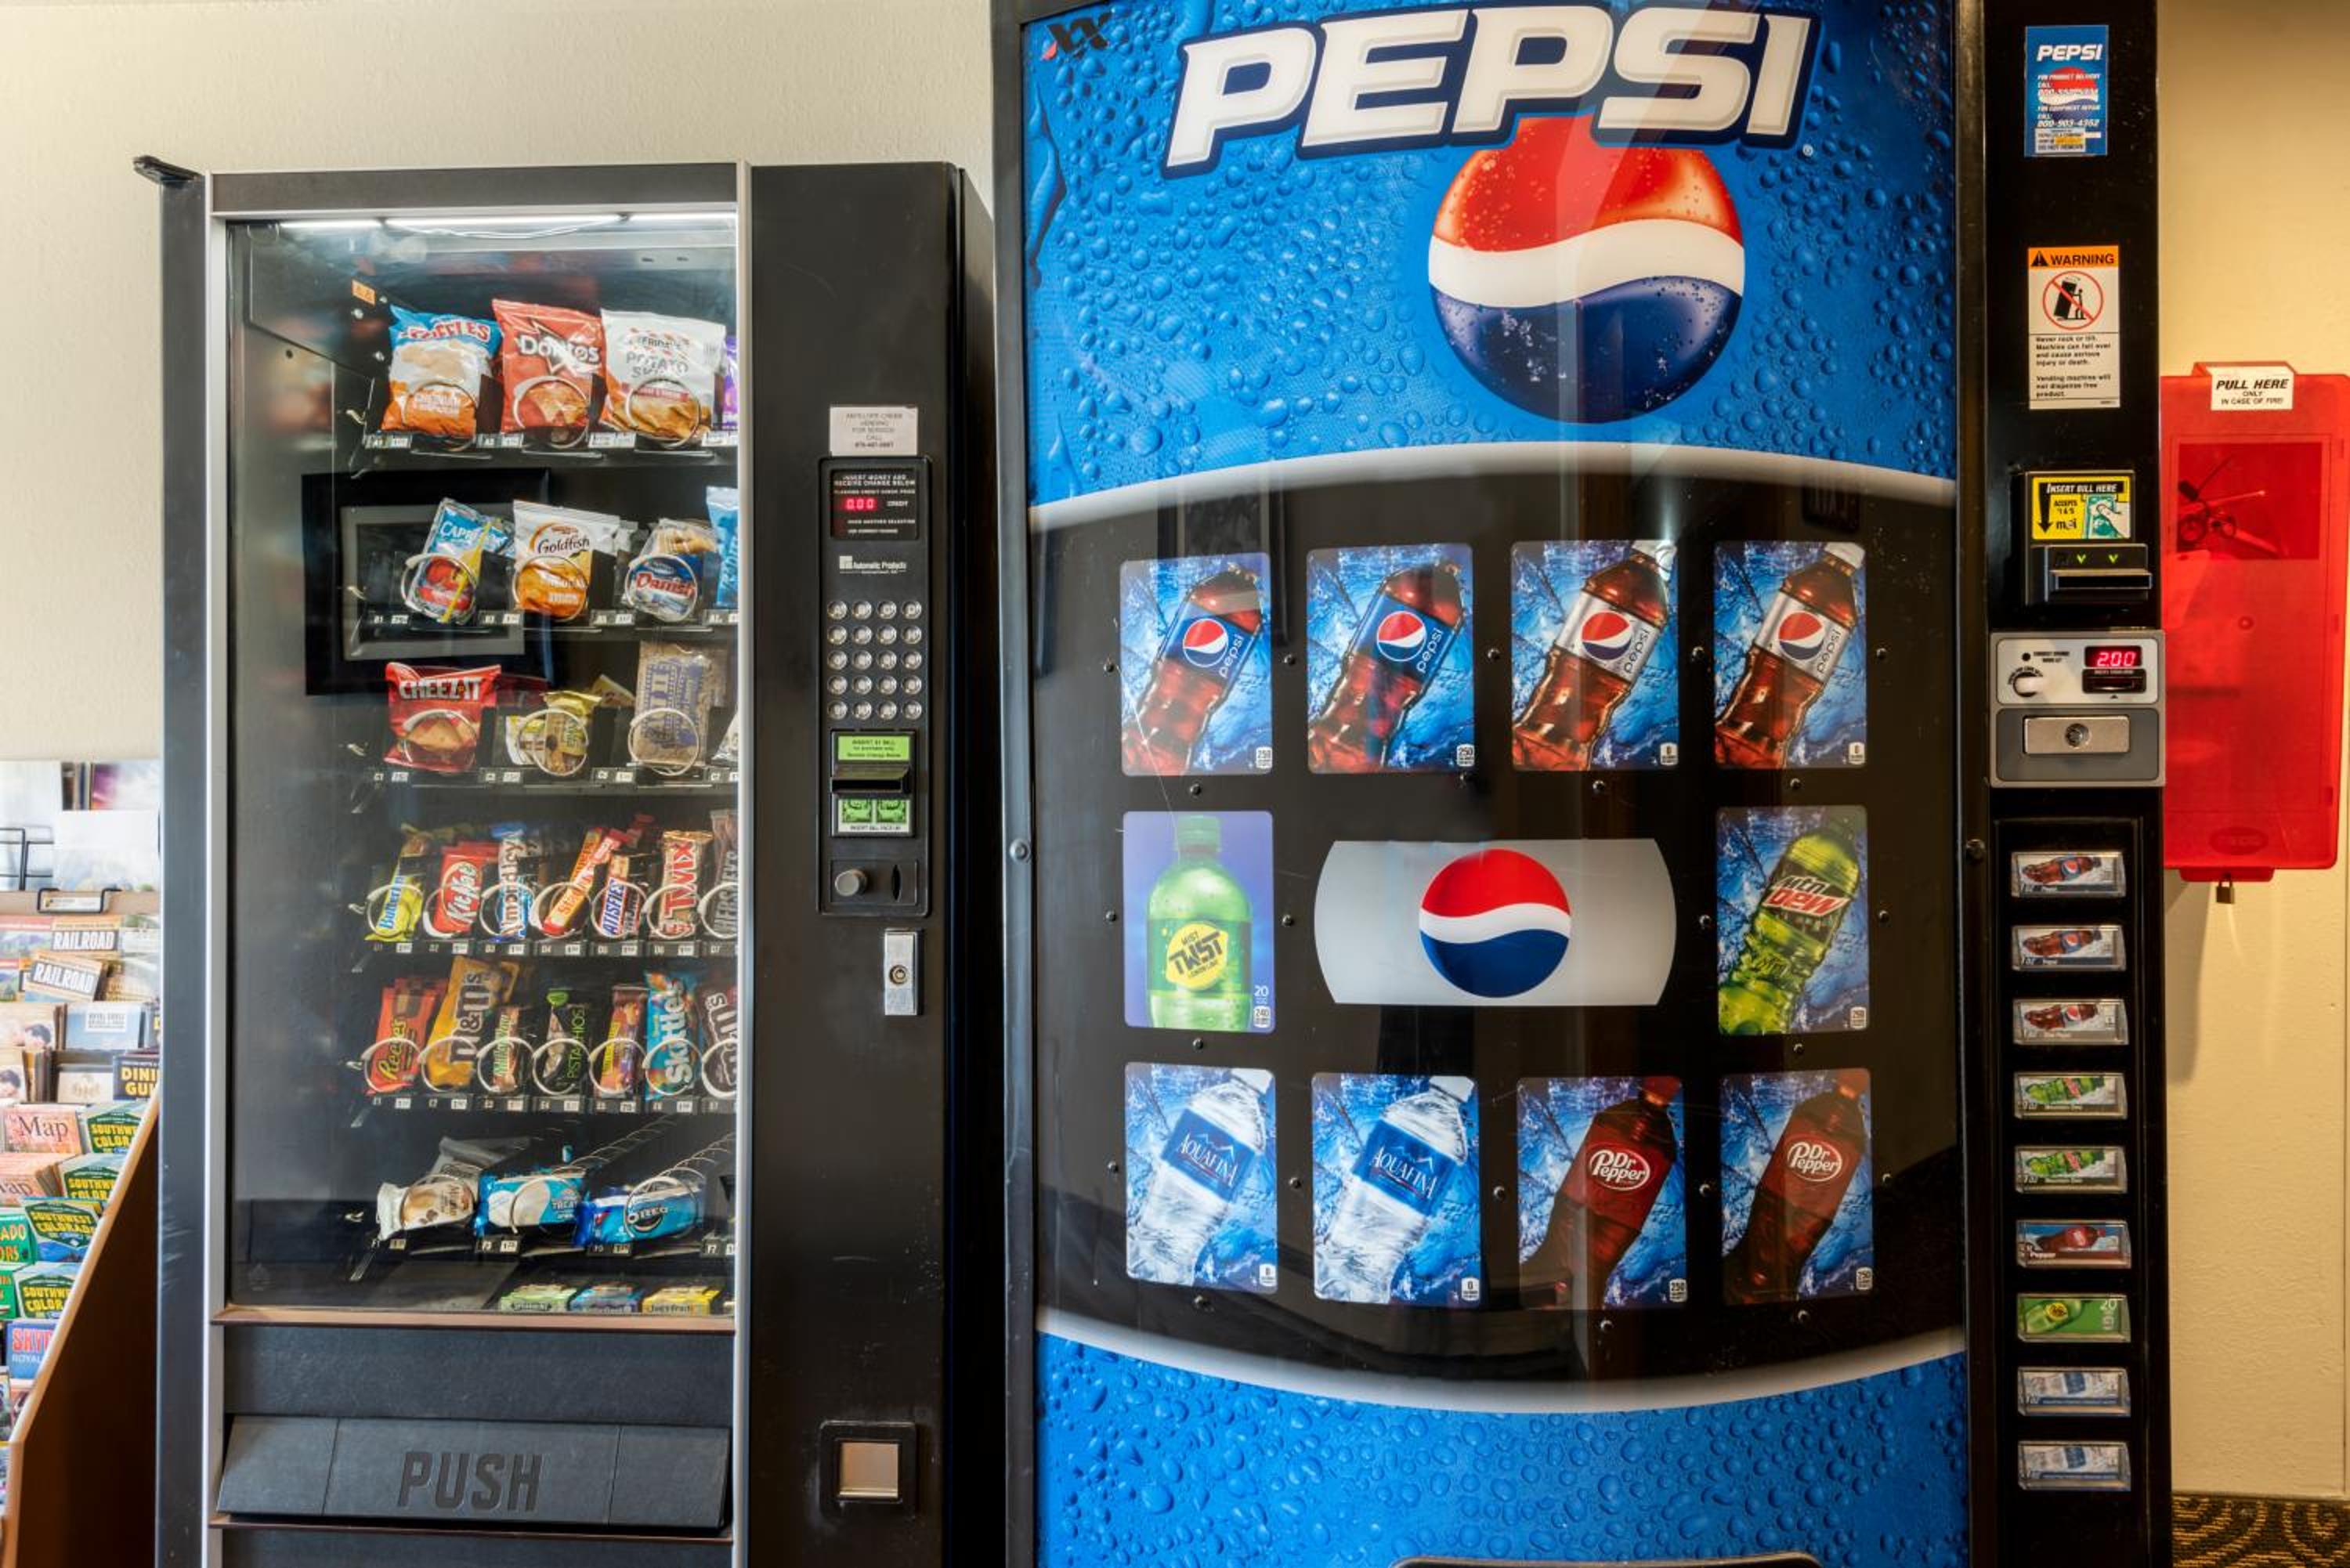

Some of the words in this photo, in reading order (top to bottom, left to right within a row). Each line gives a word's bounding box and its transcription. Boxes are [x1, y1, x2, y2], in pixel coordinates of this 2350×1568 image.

[2037, 44, 2102, 62] PEPSI
[1166, 5, 1812, 167] PEPSI
[2050, 254, 2114, 266] WARNING
[2216, 379, 2248, 390] PULL
[2254, 379, 2289, 390] HERE
[2047, 484, 2075, 493] INSERT
[2077, 484, 2094, 493] BILL
[2095, 484, 2117, 493] HERE
[537, 536, 591, 555] Goldfish
[635, 573, 696, 598] Danish
[1219, 633, 1244, 679] pepsi
[1416, 627, 1444, 674] pepsi
[1624, 627, 1651, 674] pepsi
[1816, 629, 1843, 675] pepsi
[2096, 652, 2136, 667] 2.00
[52, 930, 115, 951] RAILROAD
[32, 962, 95, 994] RAILROAD
[1254, 985, 1269, 997] 20
[19, 1117, 68, 1144] Map
[1180, 1132, 1238, 1187] AQUAFINA
[1589, 1148, 1647, 1182] Pepper
[1612, 1152, 1636, 1169] Dr
[1788, 1141, 1840, 1173] Pepper
[1810, 1147, 1831, 1161] Dr
[1371, 1146, 1438, 1200] AQUAFINA
[627, 1205, 668, 1225] OREO
[2099, 1299, 2117, 1310] 20
[397, 1451, 547, 1512] PUSH
